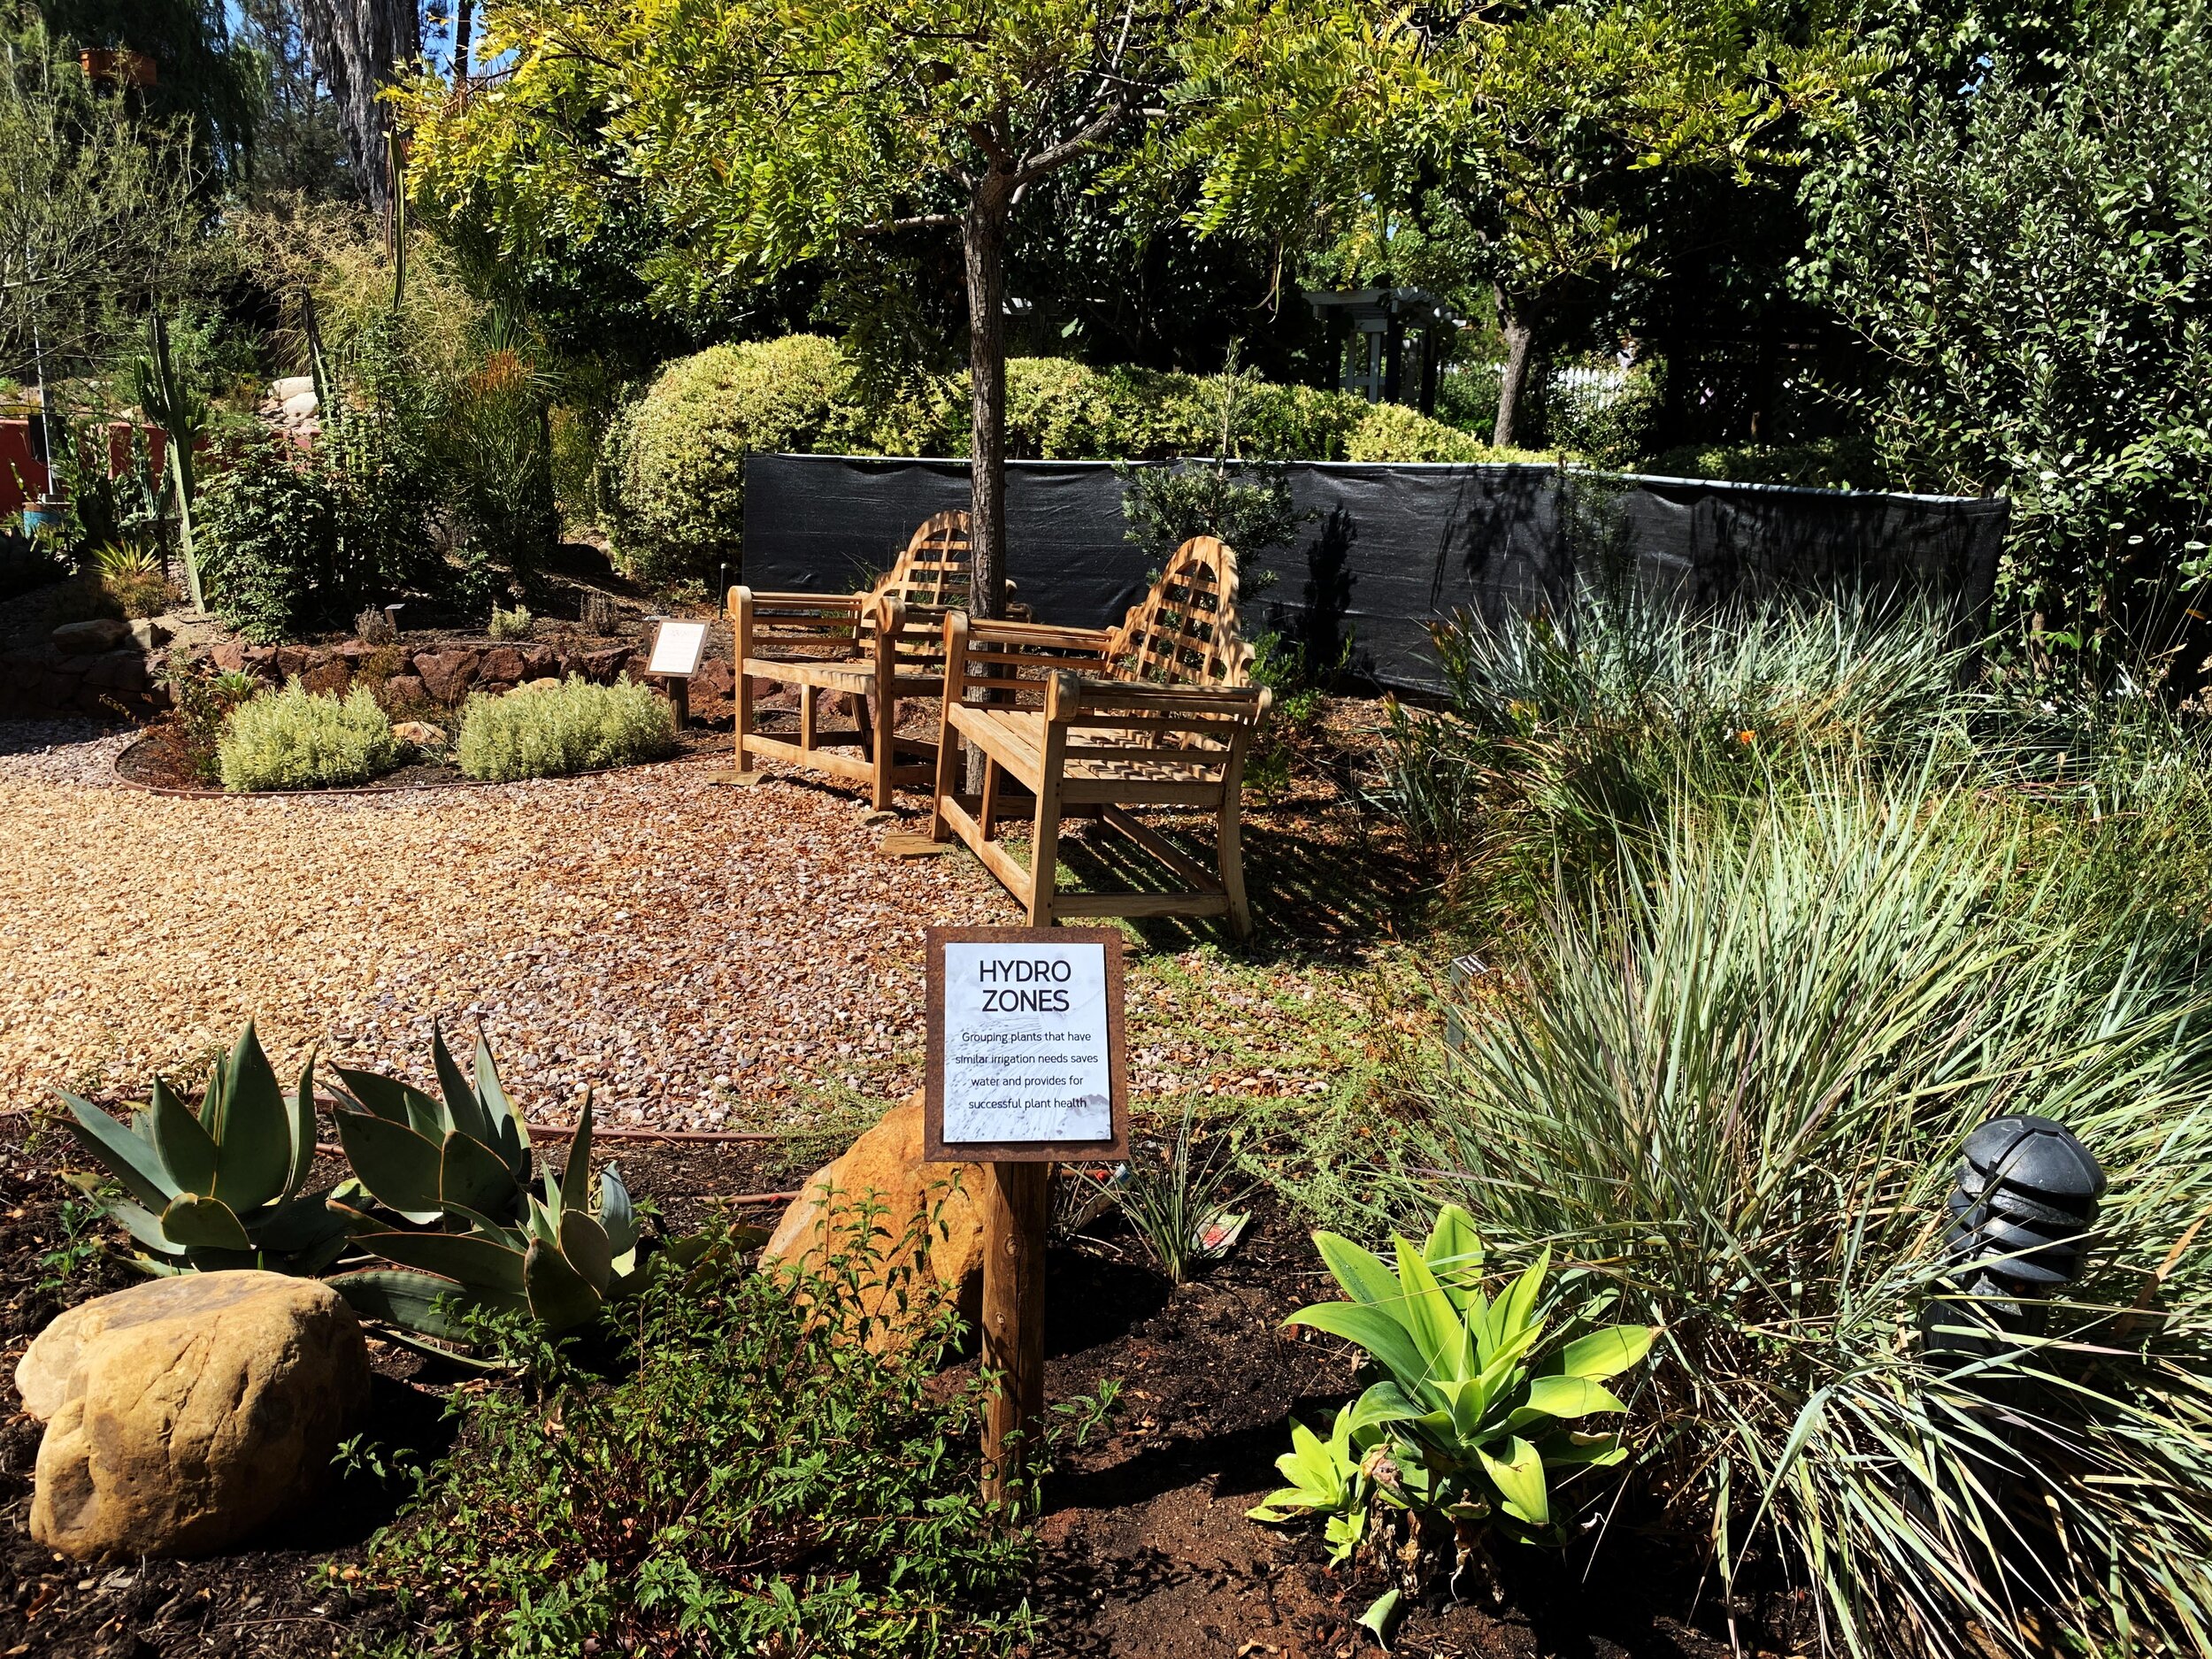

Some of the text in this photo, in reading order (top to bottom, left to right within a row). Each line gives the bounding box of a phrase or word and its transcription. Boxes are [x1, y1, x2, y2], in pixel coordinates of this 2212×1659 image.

[979, 959, 1071, 983] HYDRO
[981, 988, 1071, 1012] ZONES
[962, 1032, 1091, 1044] Grouping plants that have
[955, 1053, 1099, 1066] similar irrigation needs saves
[971, 1075, 1084, 1088] water and provides for
[968, 1097, 1087, 1110] successful plant health
